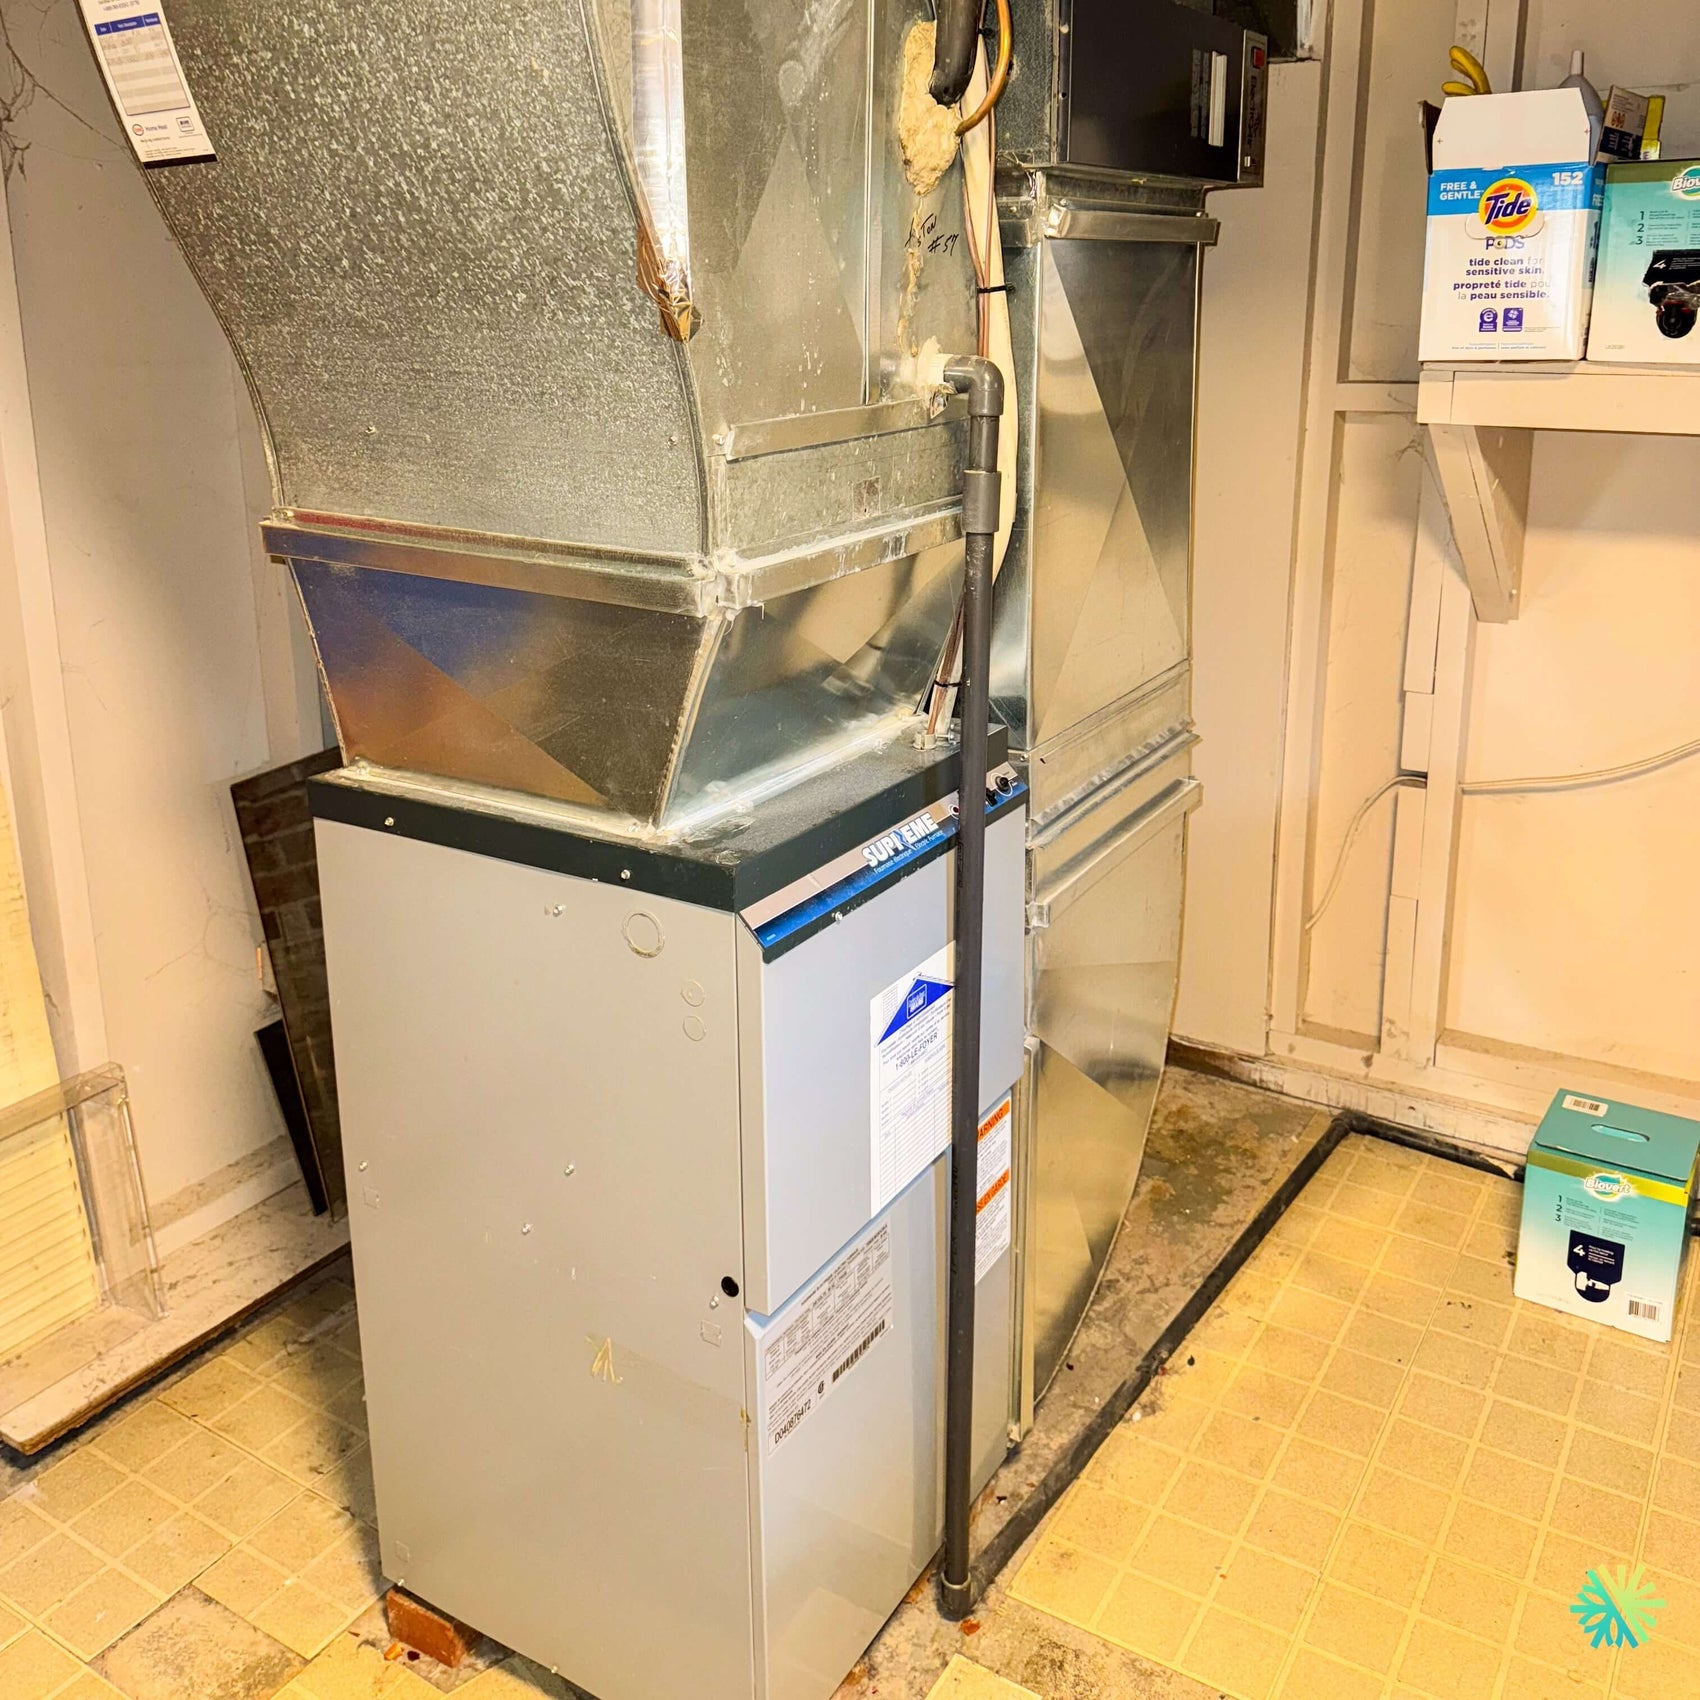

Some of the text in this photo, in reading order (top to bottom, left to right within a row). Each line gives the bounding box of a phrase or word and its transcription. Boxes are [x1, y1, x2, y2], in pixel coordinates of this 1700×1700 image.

[1552, 171, 1584, 186] 152
[1440, 181, 1477, 191] FREE &
[1484, 190, 1532, 225] Tide
[1639, 211, 1644, 220] 1
[1636, 223, 1645, 232] 2
[1634, 235, 1644, 245] 3
[1469, 258, 1491, 266] tide
[1494, 257, 1524, 266] clean
[1653, 259, 1667, 269] 4
[1465, 266, 1515, 276] sensitive
[1453, 280, 1551, 291] propreté tide pou
[1458, 291, 1467, 300] la
[1470, 292, 1497, 301] peau
[979, 1107, 1003, 1137] ARNING
[1556, 1204, 1562, 1212] 2
[1555, 1214, 1562, 1222] 3
[1573, 1244, 1586, 1257] 4
